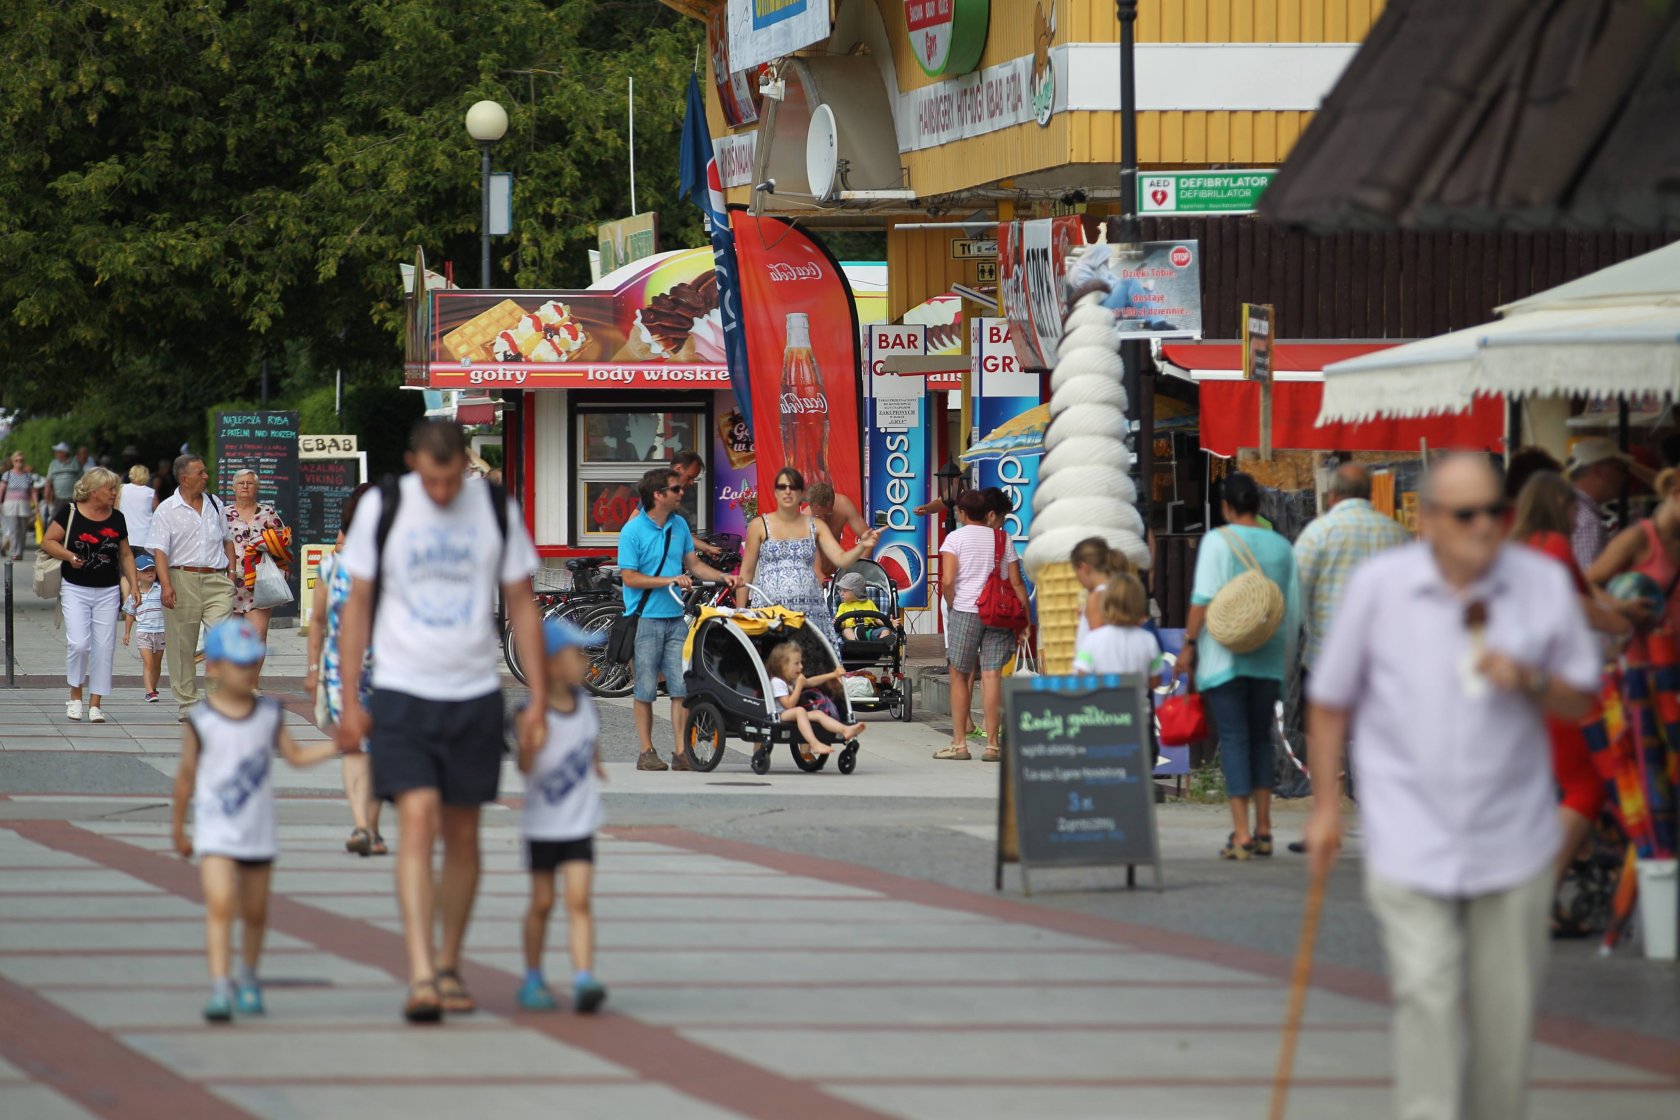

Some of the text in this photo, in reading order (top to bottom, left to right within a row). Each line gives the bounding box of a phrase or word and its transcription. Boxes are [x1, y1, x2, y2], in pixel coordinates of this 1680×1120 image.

[1149, 176, 1268, 188] AED DEFIBRYLATOR
[1180, 189, 1252, 199] DEFIBRILLATOR
[1173, 252, 1190, 262] STOP
[878, 333, 918, 349] BAR
[469, 366, 730, 384] gofry lody włoskie
[299, 438, 353, 453] EBAB
[880, 427, 915, 531] pepsi
